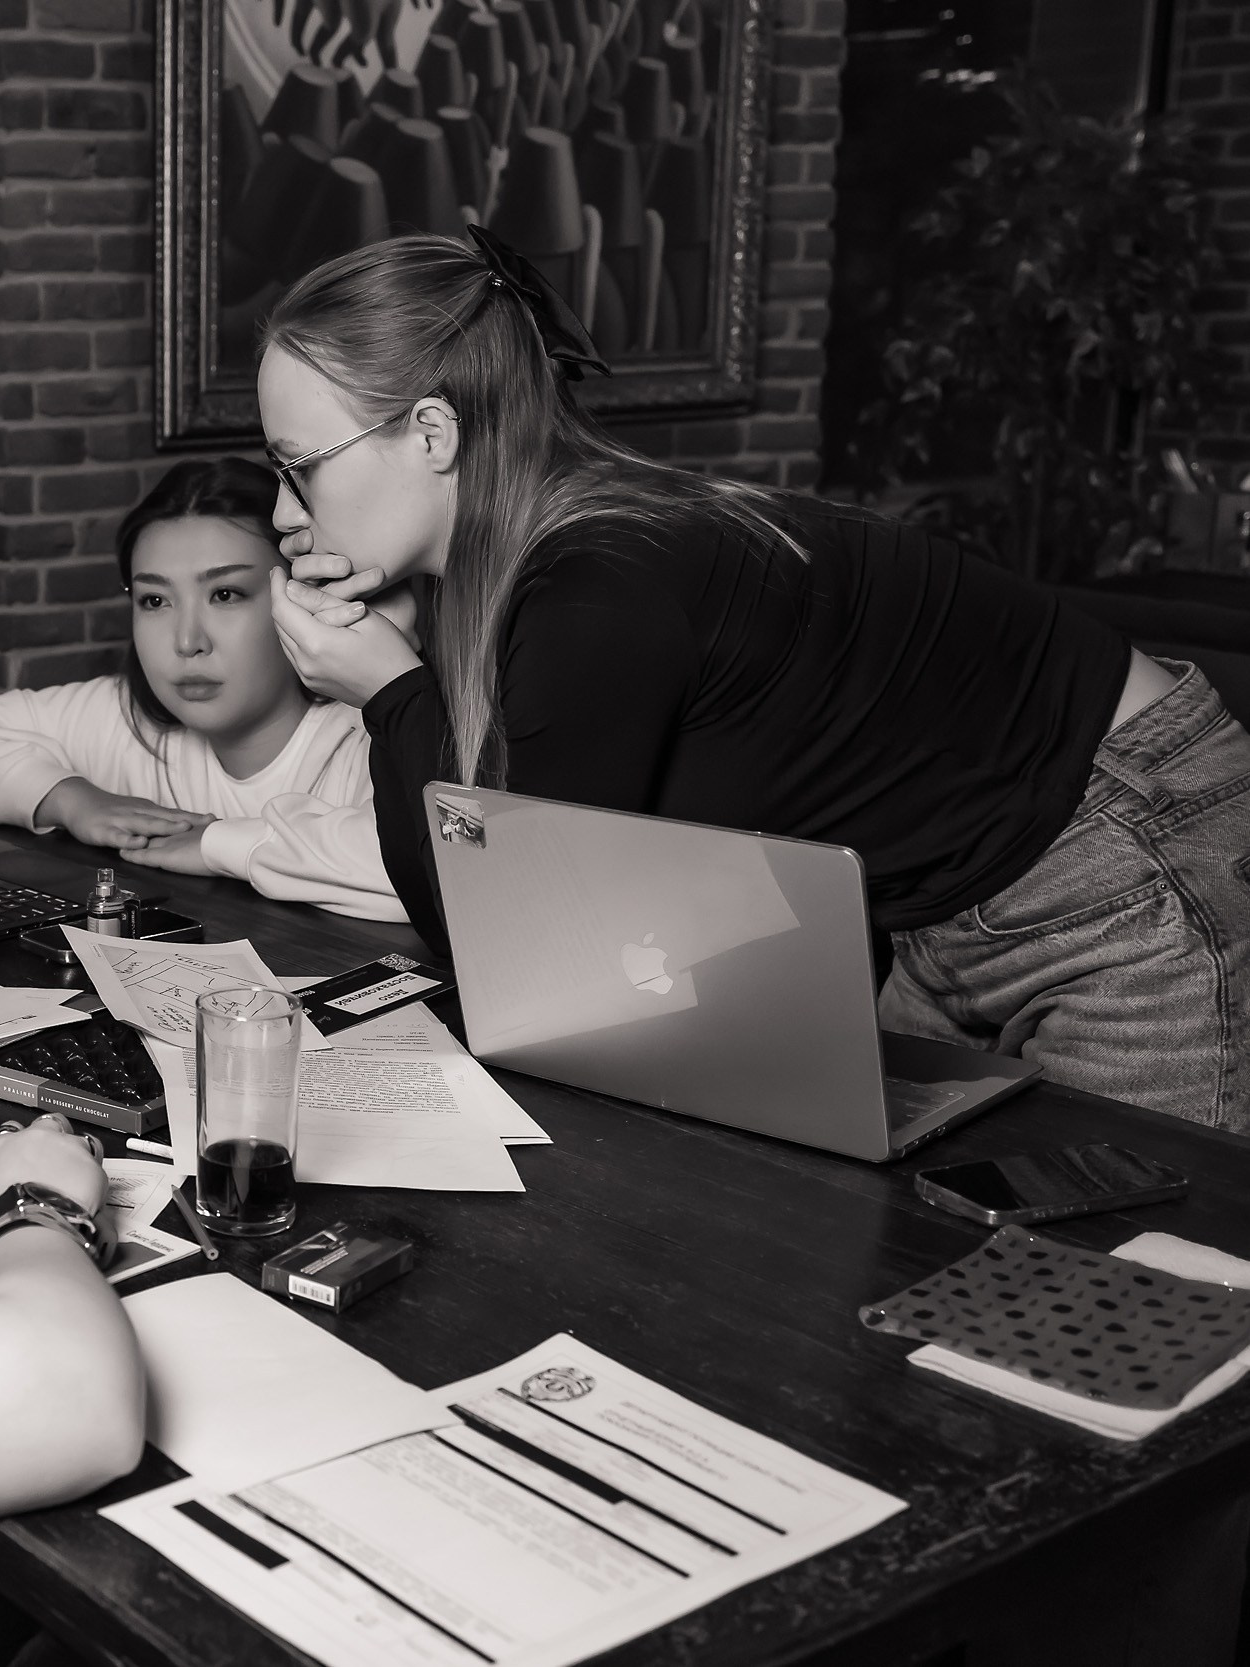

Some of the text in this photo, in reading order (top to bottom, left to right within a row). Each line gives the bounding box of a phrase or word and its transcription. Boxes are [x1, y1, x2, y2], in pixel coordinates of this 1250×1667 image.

[3, 1086, 35, 1098] PRALINES
[52, 1099, 74, 1110] DESSERT
[83, 1107, 109, 1118] CHOCOLAT
